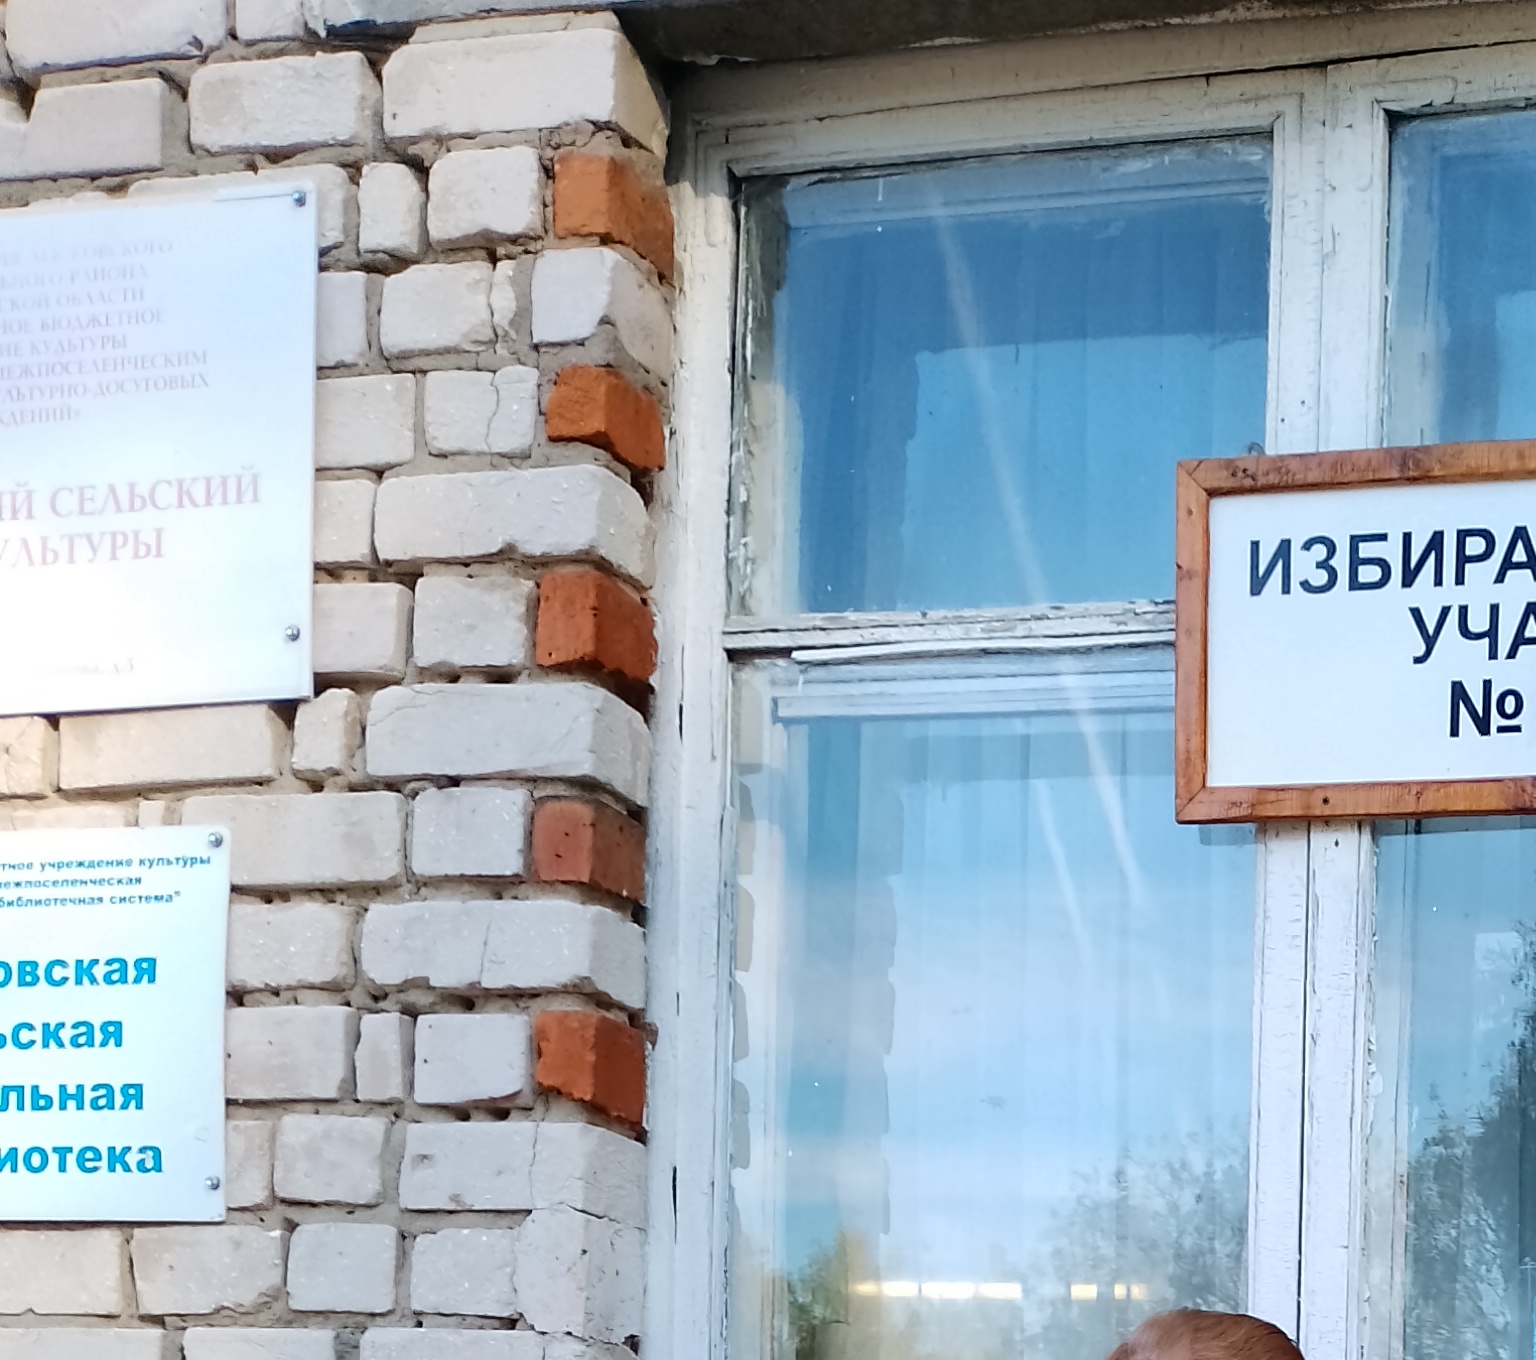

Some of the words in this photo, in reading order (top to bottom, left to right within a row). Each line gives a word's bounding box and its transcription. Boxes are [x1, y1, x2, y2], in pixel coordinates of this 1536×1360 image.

[57, 286, 145, 307] ОБЛАСТИ
[41, 308, 164, 334] БЮДЖЕТНОЕ
[30, 334, 128, 357] КУЛЬТУРЫ
[0, 372, 209, 405] ЛЬТУРНО-ДОСУГОВЫХ
[48, 464, 262, 518] СЕЛЬСКИЙ
[1450, 678, 1523, 738] №
[40, 857, 133, 875] учреждение
[138, 854, 211, 871] культуры
[0, 875, 142, 889] ежпоселенческая
[0, 1082, 143, 1112] льная
